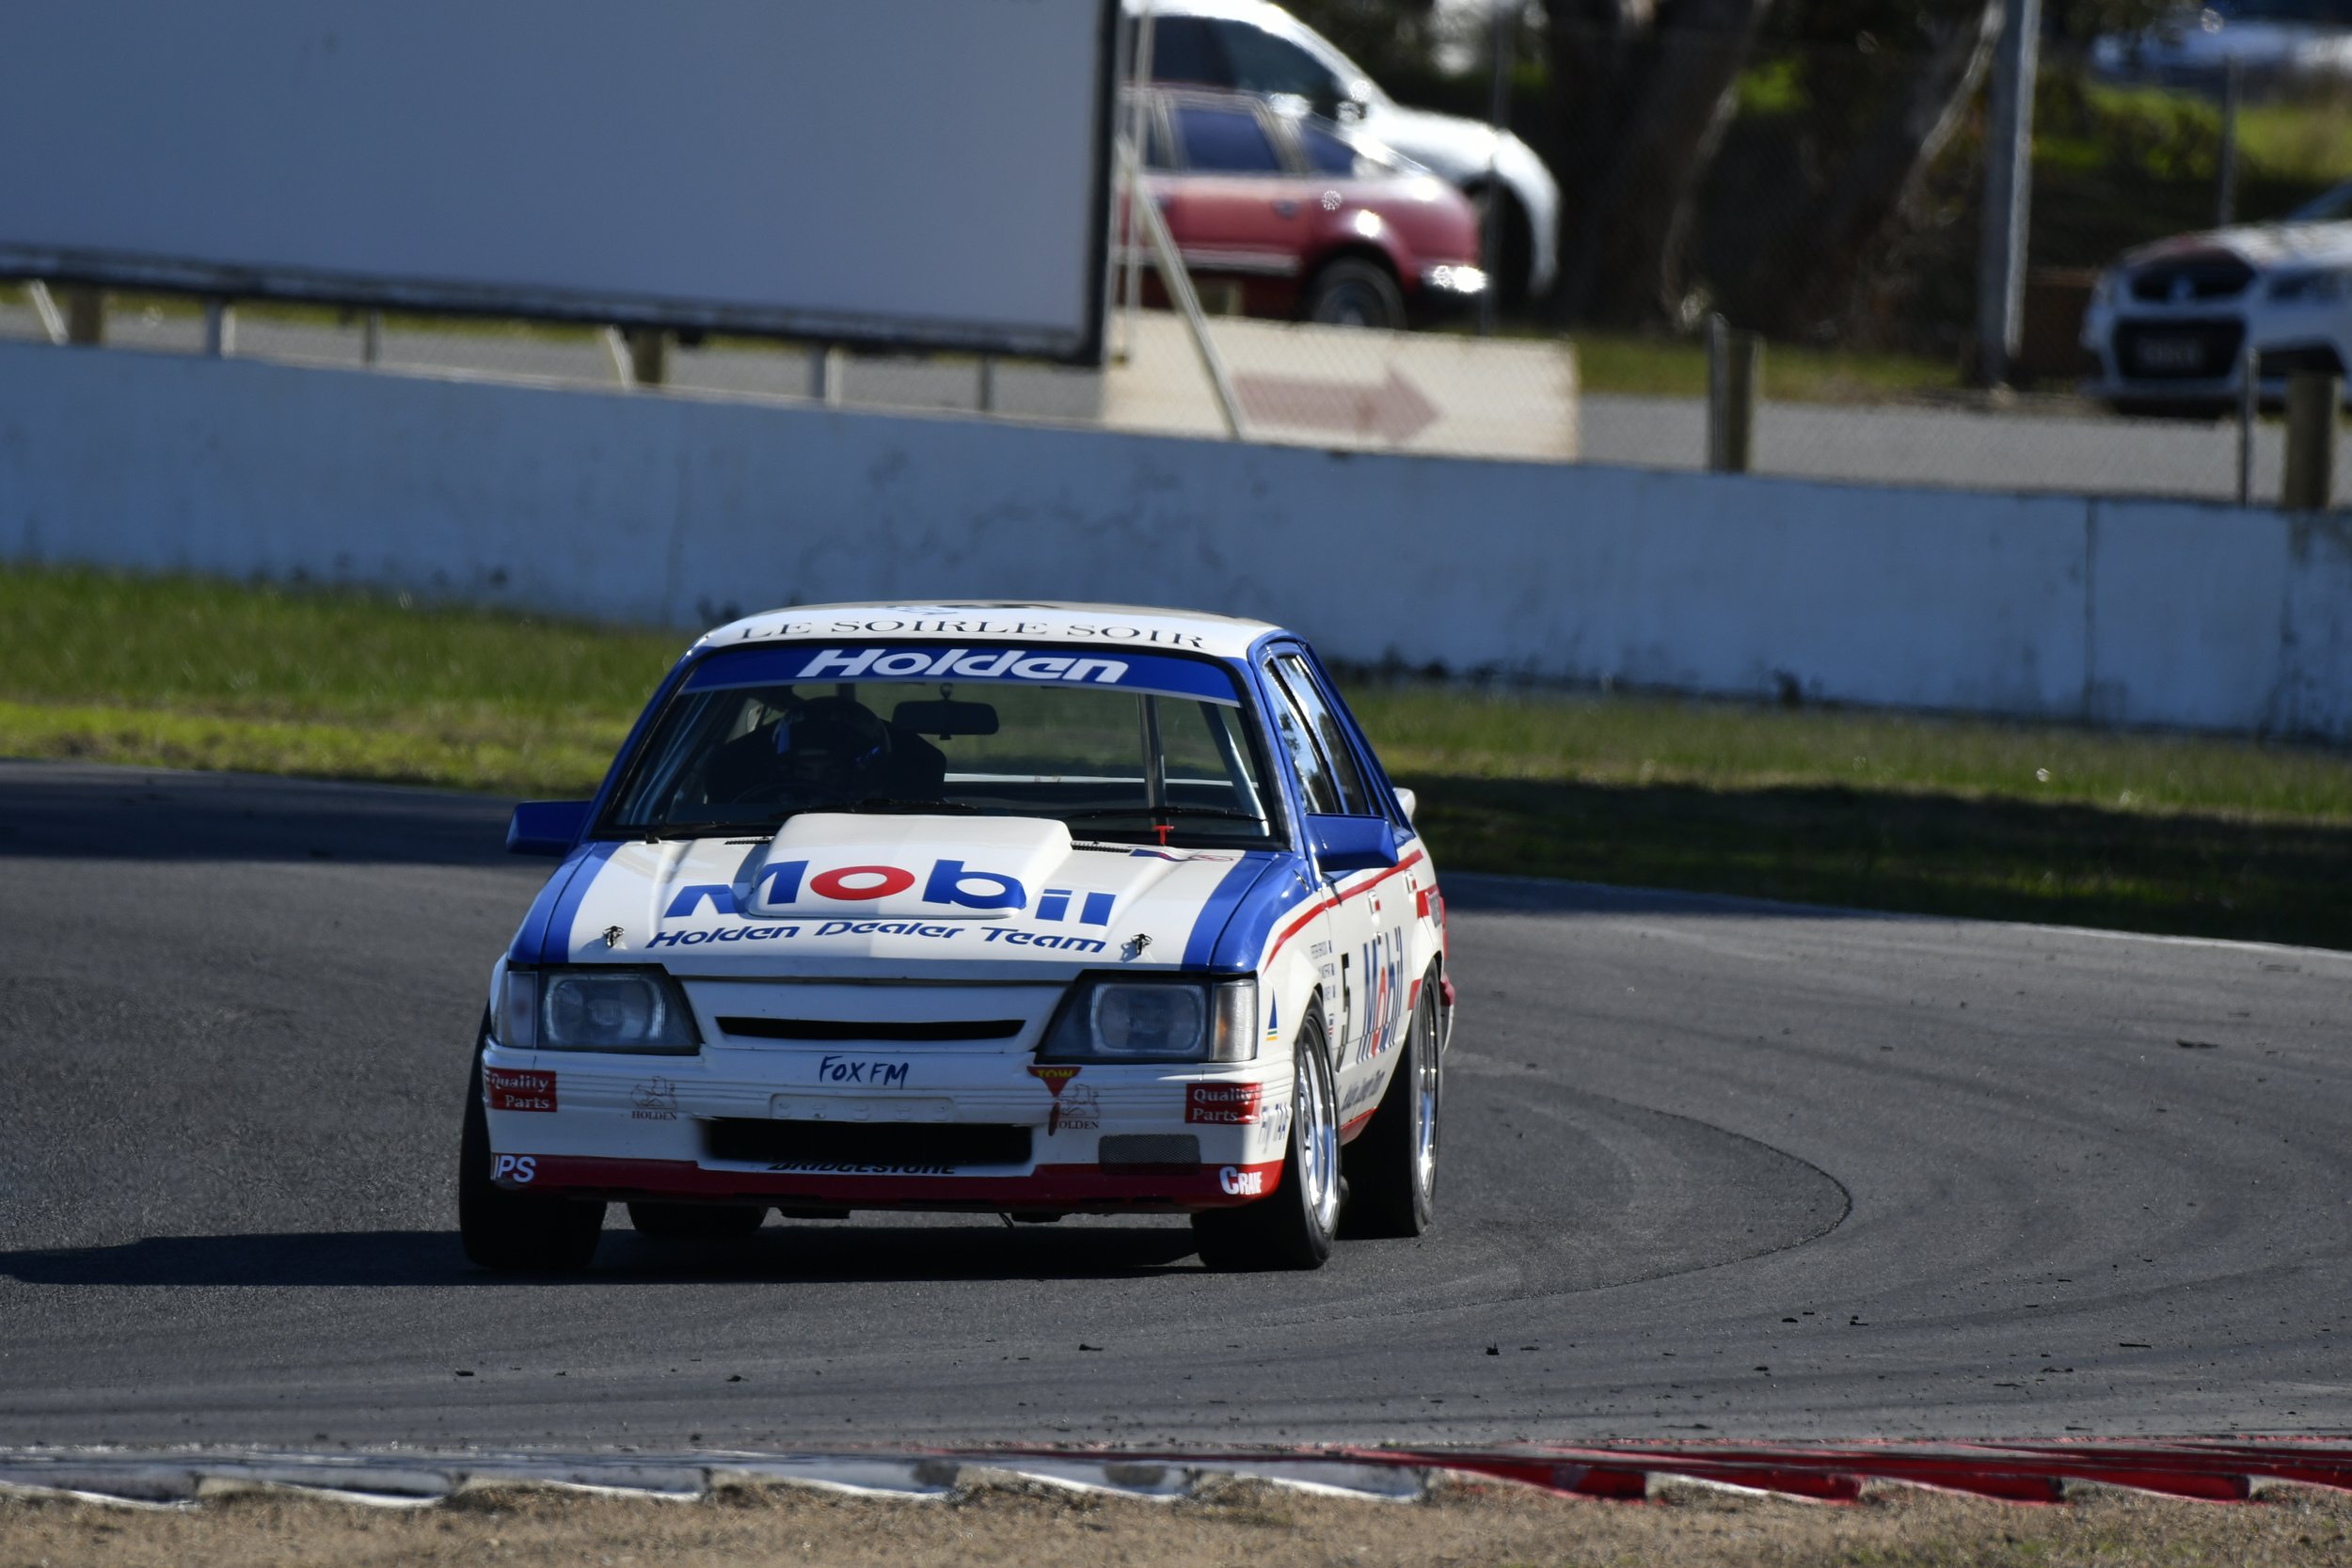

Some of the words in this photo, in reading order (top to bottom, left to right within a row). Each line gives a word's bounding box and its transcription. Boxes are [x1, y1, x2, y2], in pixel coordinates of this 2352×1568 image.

[741, 622, 812, 640] LE
[1067, 625, 1205, 649] SOIR
[795, 648, 1129, 684] Holden
[663, 859, 1116, 927] Mobil
[644, 926, 802, 949] Holden
[814, 922, 964, 939] Dealer
[980, 927, 1106, 954] Team
[491, 1073, 549, 1093] Quality
[869, 1062, 910, 1090] FM
[1037, 1069, 1074, 1078] TOW
[505, 1094, 550, 1109] Parts
[631, 1110, 678, 1120] HOLDEN
[1057, 1119, 1100, 1130] OLDEN
[1192, 1107, 1239, 1122] Parts
